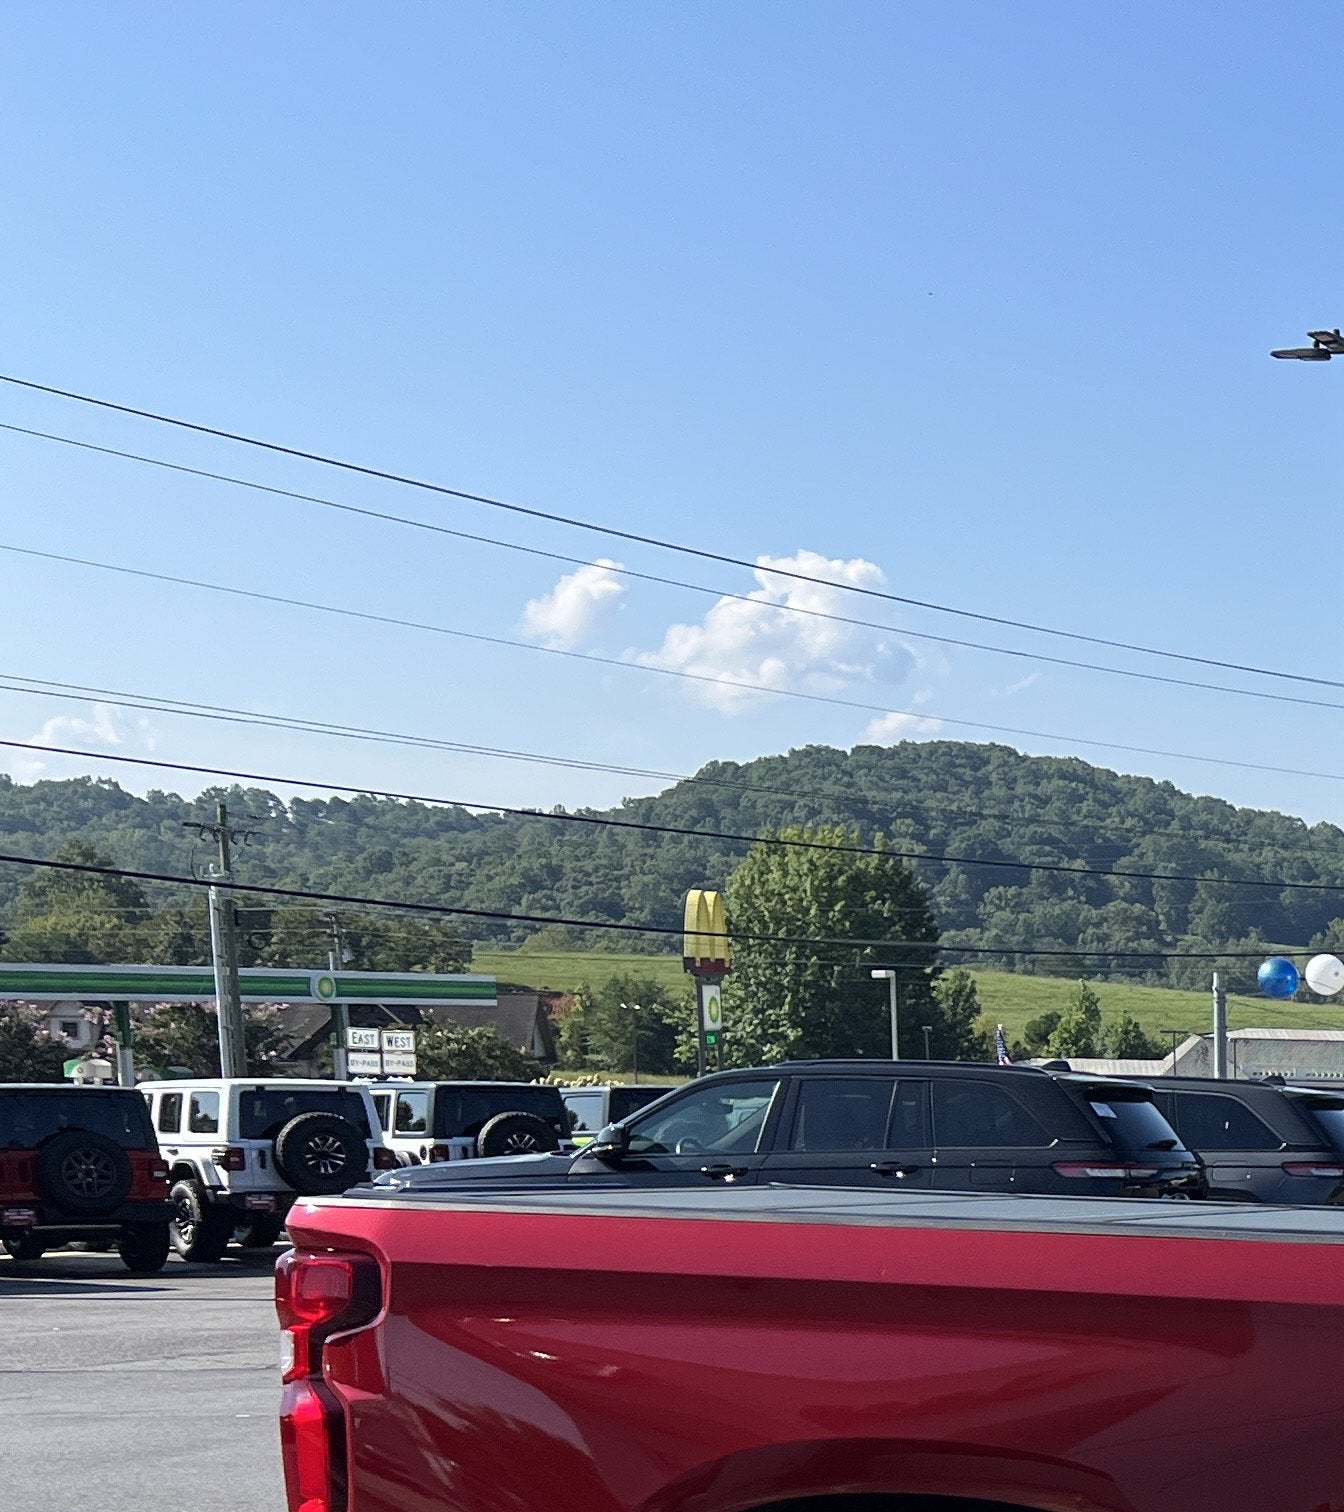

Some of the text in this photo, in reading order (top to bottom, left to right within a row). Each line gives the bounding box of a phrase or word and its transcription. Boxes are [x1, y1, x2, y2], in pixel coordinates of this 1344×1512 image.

[351, 1031, 375, 1045] EAST
[385, 1035, 411, 1048] WEST
[350, 1059, 379, 1067] BY-PASS
[385, 1059, 414, 1068] BY-PASS
